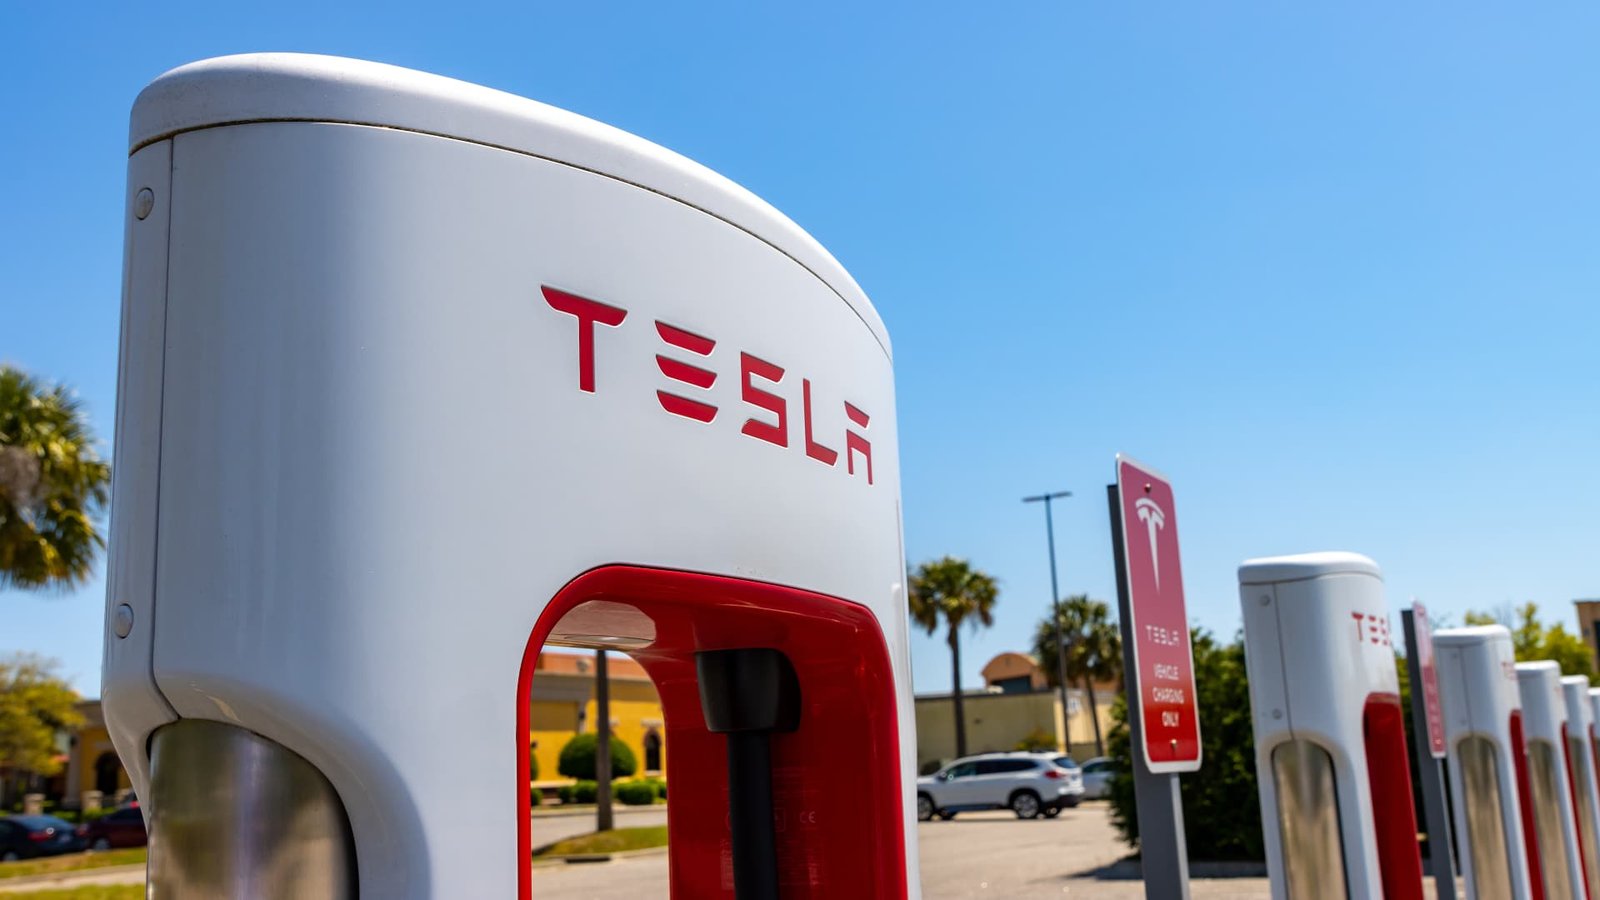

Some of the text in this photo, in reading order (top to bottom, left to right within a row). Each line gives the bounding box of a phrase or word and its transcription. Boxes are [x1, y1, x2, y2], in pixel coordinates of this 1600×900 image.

[540, 284, 874, 486] TESLA
[1146, 625, 1179, 646] TESLA
[1352, 612, 1387, 646] TES
[1152, 687, 1184, 704] CHARGING
[1162, 711, 1179, 727] ONLY
